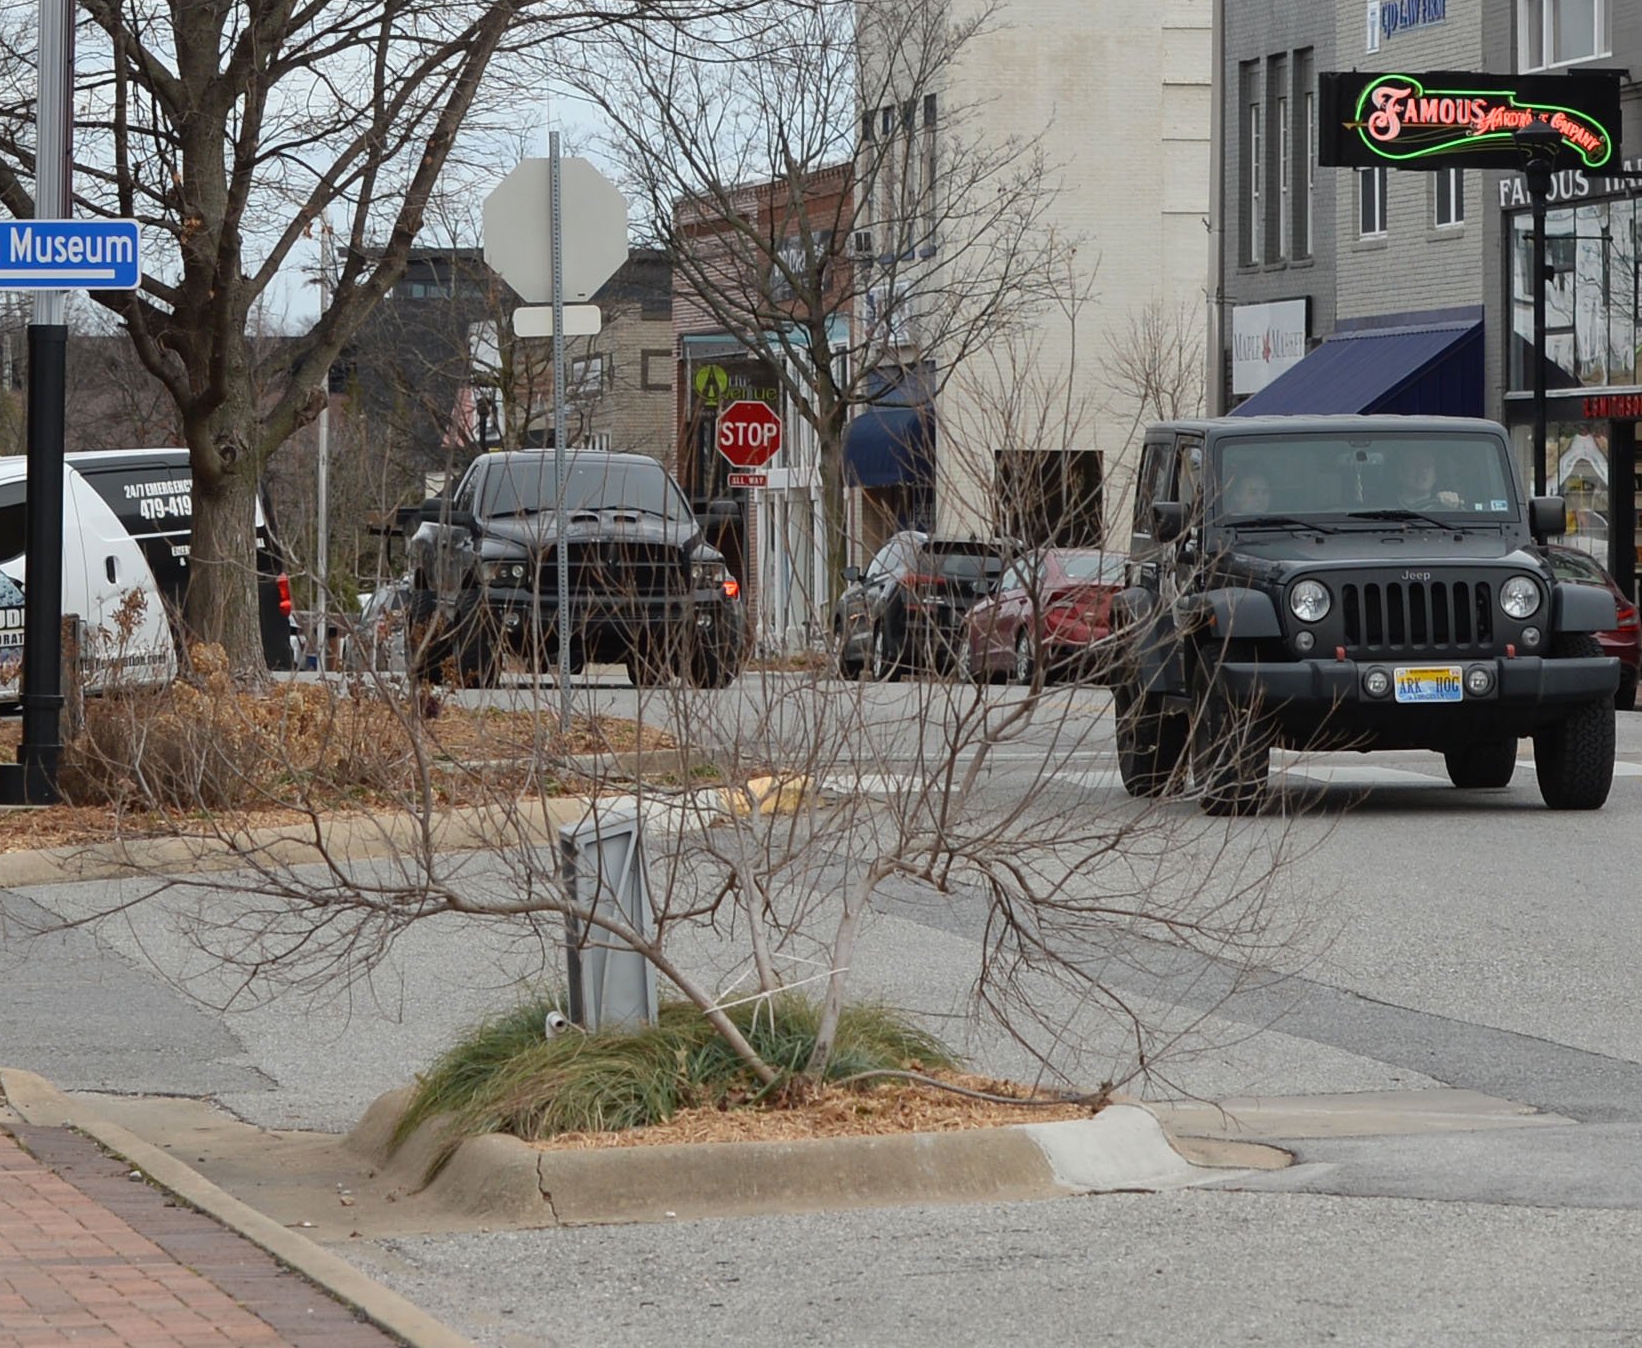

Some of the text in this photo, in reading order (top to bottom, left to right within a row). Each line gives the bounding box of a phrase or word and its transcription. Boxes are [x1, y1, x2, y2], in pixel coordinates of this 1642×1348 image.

[1368, 86, 1488, 141] FAMOUS
[1499, 168, 1589, 207] FAOUS
[10, 227, 133, 263] Museum
[721, 421, 777, 447] STOP
[732, 475, 764, 485] ALL WAY
[124, 484, 145, 499] 24/7
[1401, 570, 1431, 581] Jeep
[1399, 676, 1459, 693] ARK HOG
